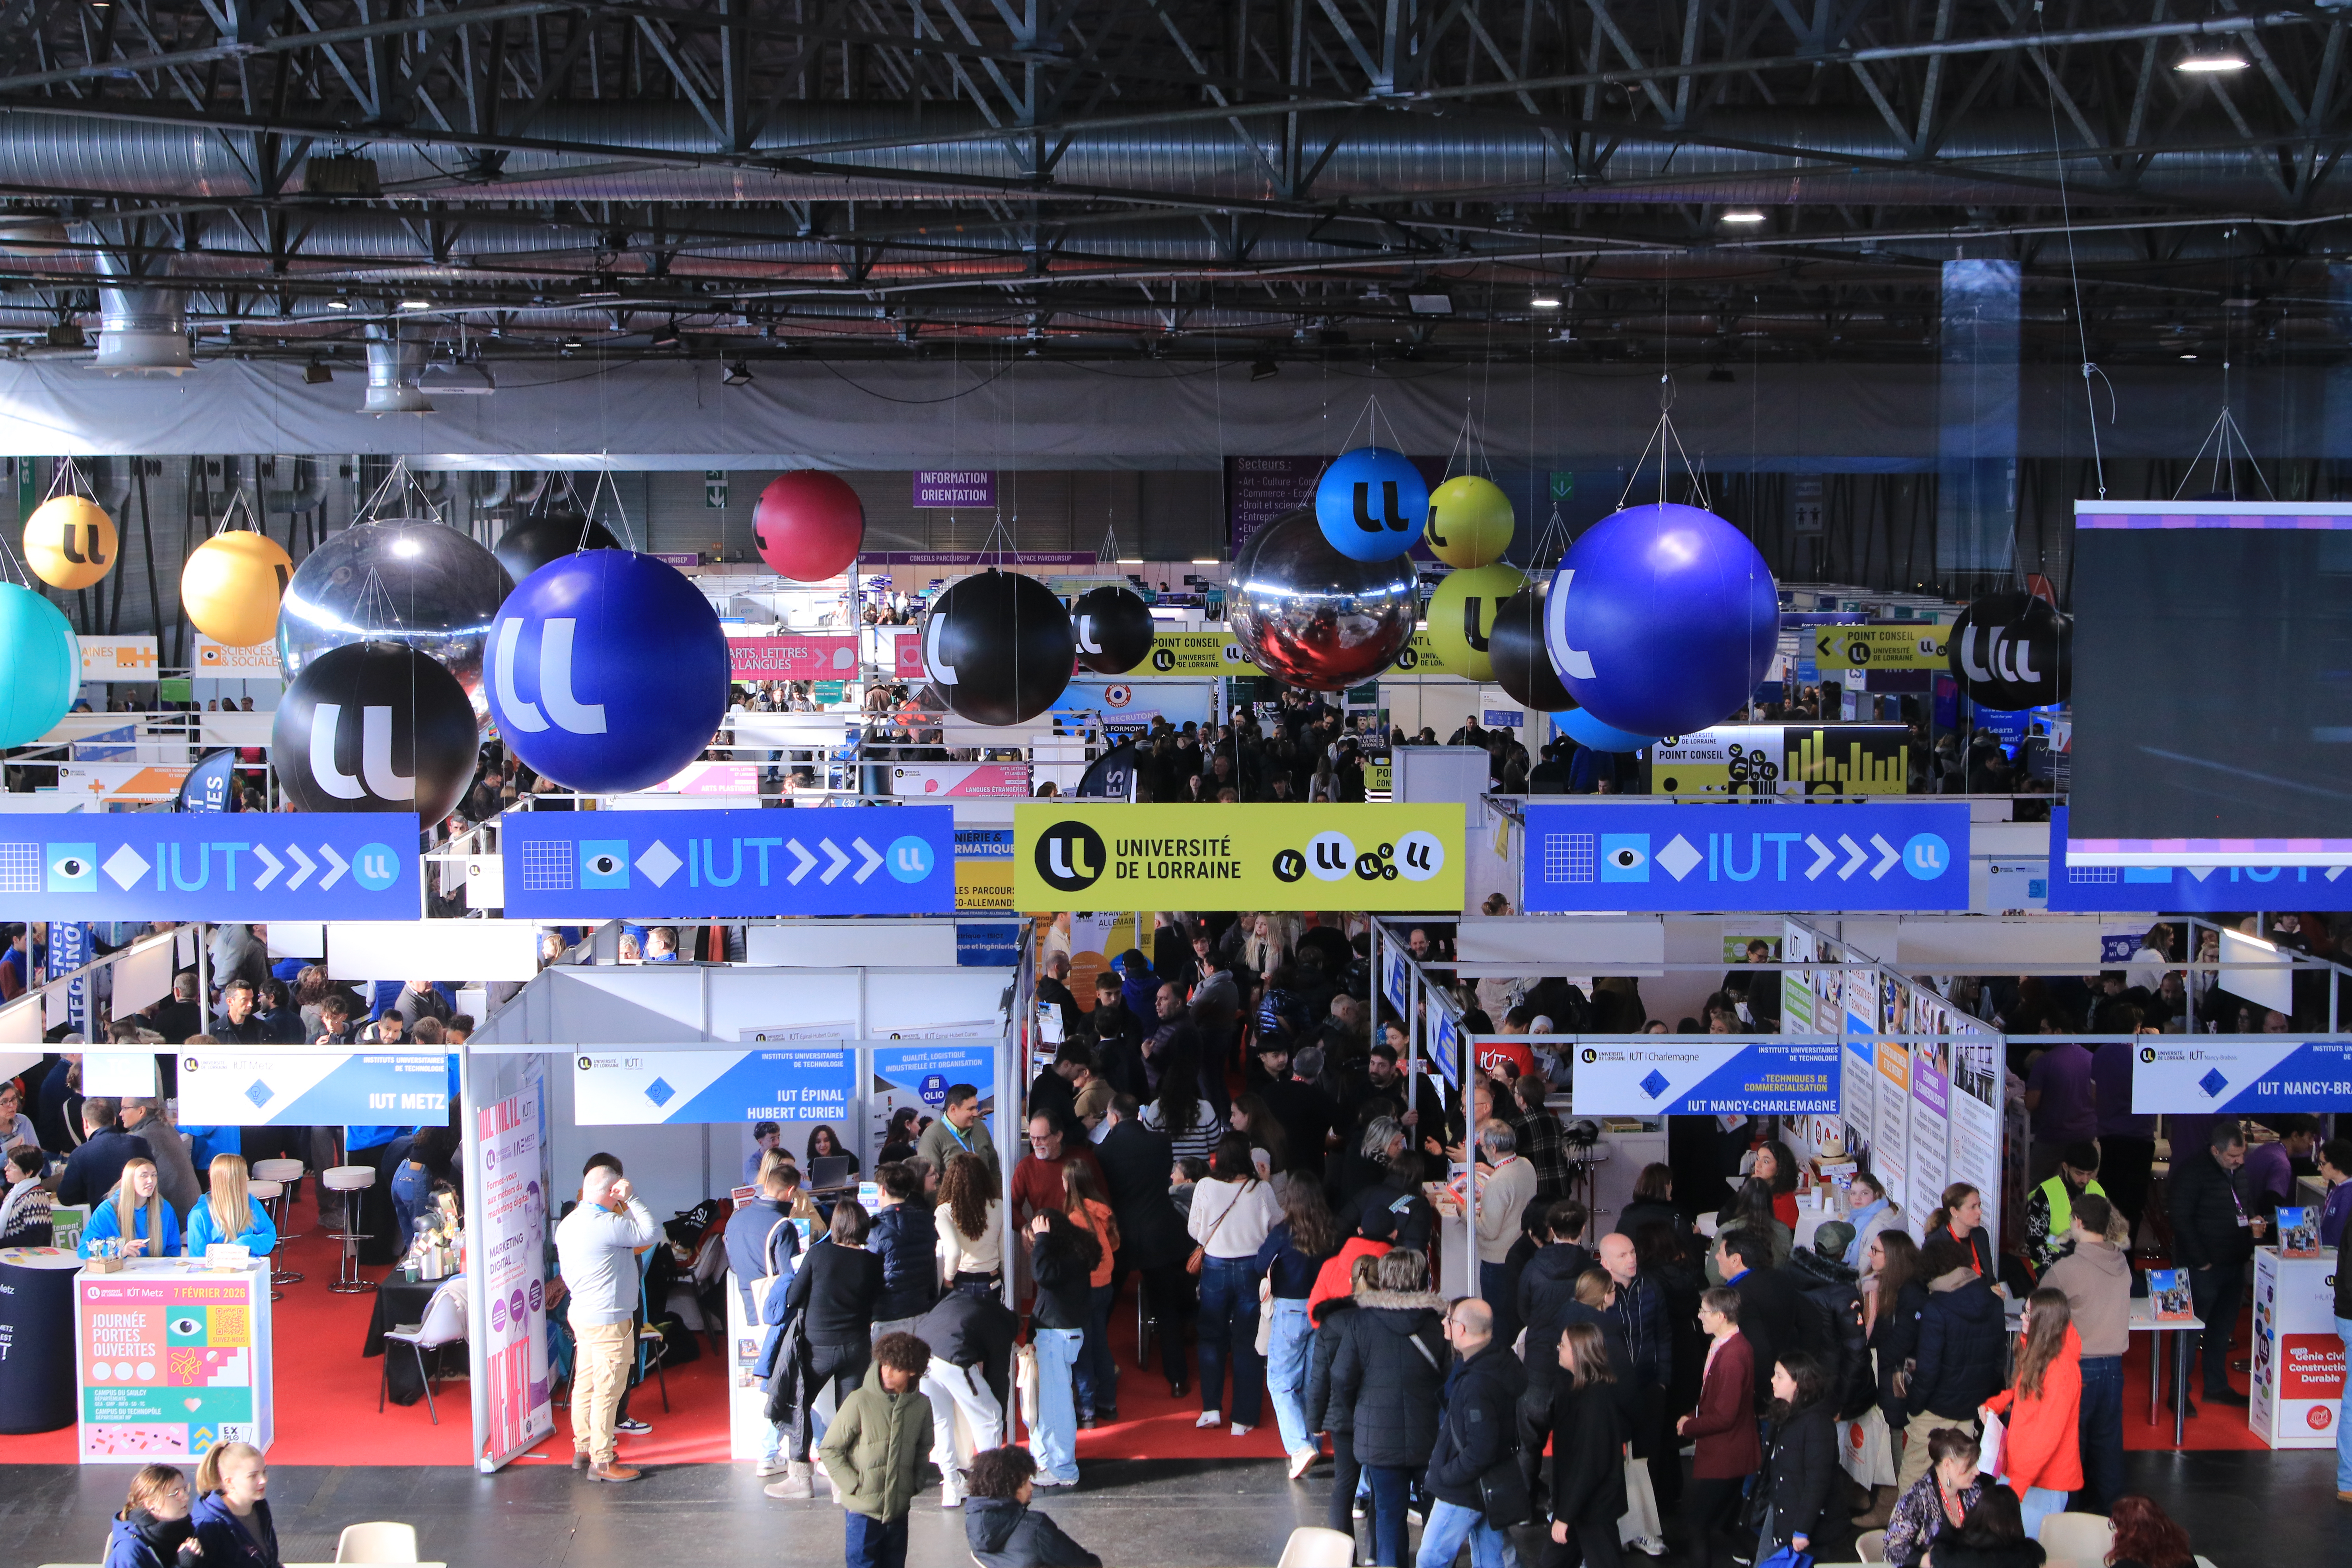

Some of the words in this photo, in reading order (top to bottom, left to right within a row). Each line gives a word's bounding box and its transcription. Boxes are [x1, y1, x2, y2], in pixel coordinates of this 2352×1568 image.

[1238, 458, 1285, 469] Secteurs
[921, 472, 987, 484] INFORMATION
[1263, 477, 1290, 485] Culture
[921, 489, 987, 501] ORIENTATION
[1244, 489, 1285, 497] Commerce
[1244, 500, 1262, 509] Droit
[1848, 632, 1876, 641] POINT
[1880, 631, 1914, 641] CONSEIL
[1153, 639, 1181, 647] POINT
[1184, 638, 1220, 647] CONSEIL
[220, 645, 273, 655] SCIENCES
[729, 647, 759, 659] ARTS,
[761, 647, 808, 658] LETTRES
[221, 656, 229, 666] &
[738, 659, 791, 670] LANGUES
[1110, 712, 1158, 723] RECRUTONS
[1659, 750, 1687, 759] POINT
[1690, 750, 1724, 759] CONSEIL
[993, 832, 1002, 842] &
[1116, 835, 1231, 857] UNIVERSITÉ
[689, 838, 783, 887] IUT
[1709, 833, 1801, 882] IUT
[157, 842, 250, 892] IUT
[1116, 861, 1139, 878] DE
[1148, 861, 1241, 878] LORRAINE
[902, 1053, 929, 1062] QUALITÉ,
[931, 1051, 966, 1060] LOGISTIQUE
[1630, 1050, 1644, 1061] IUT
[1649, 1052, 1699, 1063] Charlemagne
[2189, 1049, 2205, 1060] IUT
[249, 1061, 273, 1069] Metz
[625, 1056, 639, 1067] IUT
[886, 1064, 928, 1072] INDUSTRIELLE
[938, 1059, 982, 1068] ORGANISATION
[1766, 1075, 1815, 1083] TECHNIQUES
[778, 1090, 797, 1102] IUT
[802, 1087, 845, 1102] ÉPINAL
[2258, 1082, 2280, 1095] IUT
[2284, 1082, 2352, 1095] NANCY-BR
[370, 1093, 397, 1109] IUT
[401, 1093, 445, 1109] METZ
[923, 1091, 944, 1101] QLIO
[1688, 1100, 1707, 1111] IUT
[1710, 1100, 1836, 1112] NANCY-CHARLEMAGNE
[748, 1107, 796, 1119] HUBERT
[798, 1107, 844, 1119] CURIEN
[525, 1134, 535, 1143] METZ
[487, 1171, 517, 1192] Formez-vous
[487, 1196, 496, 1206] aux
[498, 1186, 515, 1202] métiers
[516, 1181, 522, 1191] du
[488, 1202, 513, 1220] marketing
[514, 1192, 530, 1210] digital
[489, 1233, 524, 1259] MARKETING
[490, 1255, 512, 1275] DIGITAL
[127, 1287, 140, 1297] IUT
[142, 1289, 164, 1297] Metz
[173, 1288, 179, 1298] 7
[182, 1286, 220, 1298] FÉVRIER
[223, 1288, 245, 1298] 2026
[92, 1311, 146, 1328] JOURNÉE
[93, 1328, 140, 1342] PORTES
[93, 1343, 156, 1357] OUVERTES
[2295, 1352, 2324, 1361] Génie
[2326, 1351, 2345, 1361] Civi
[2289, 1363, 2346, 1372] Constructio
[2301, 1374, 2340, 1383] Durable
